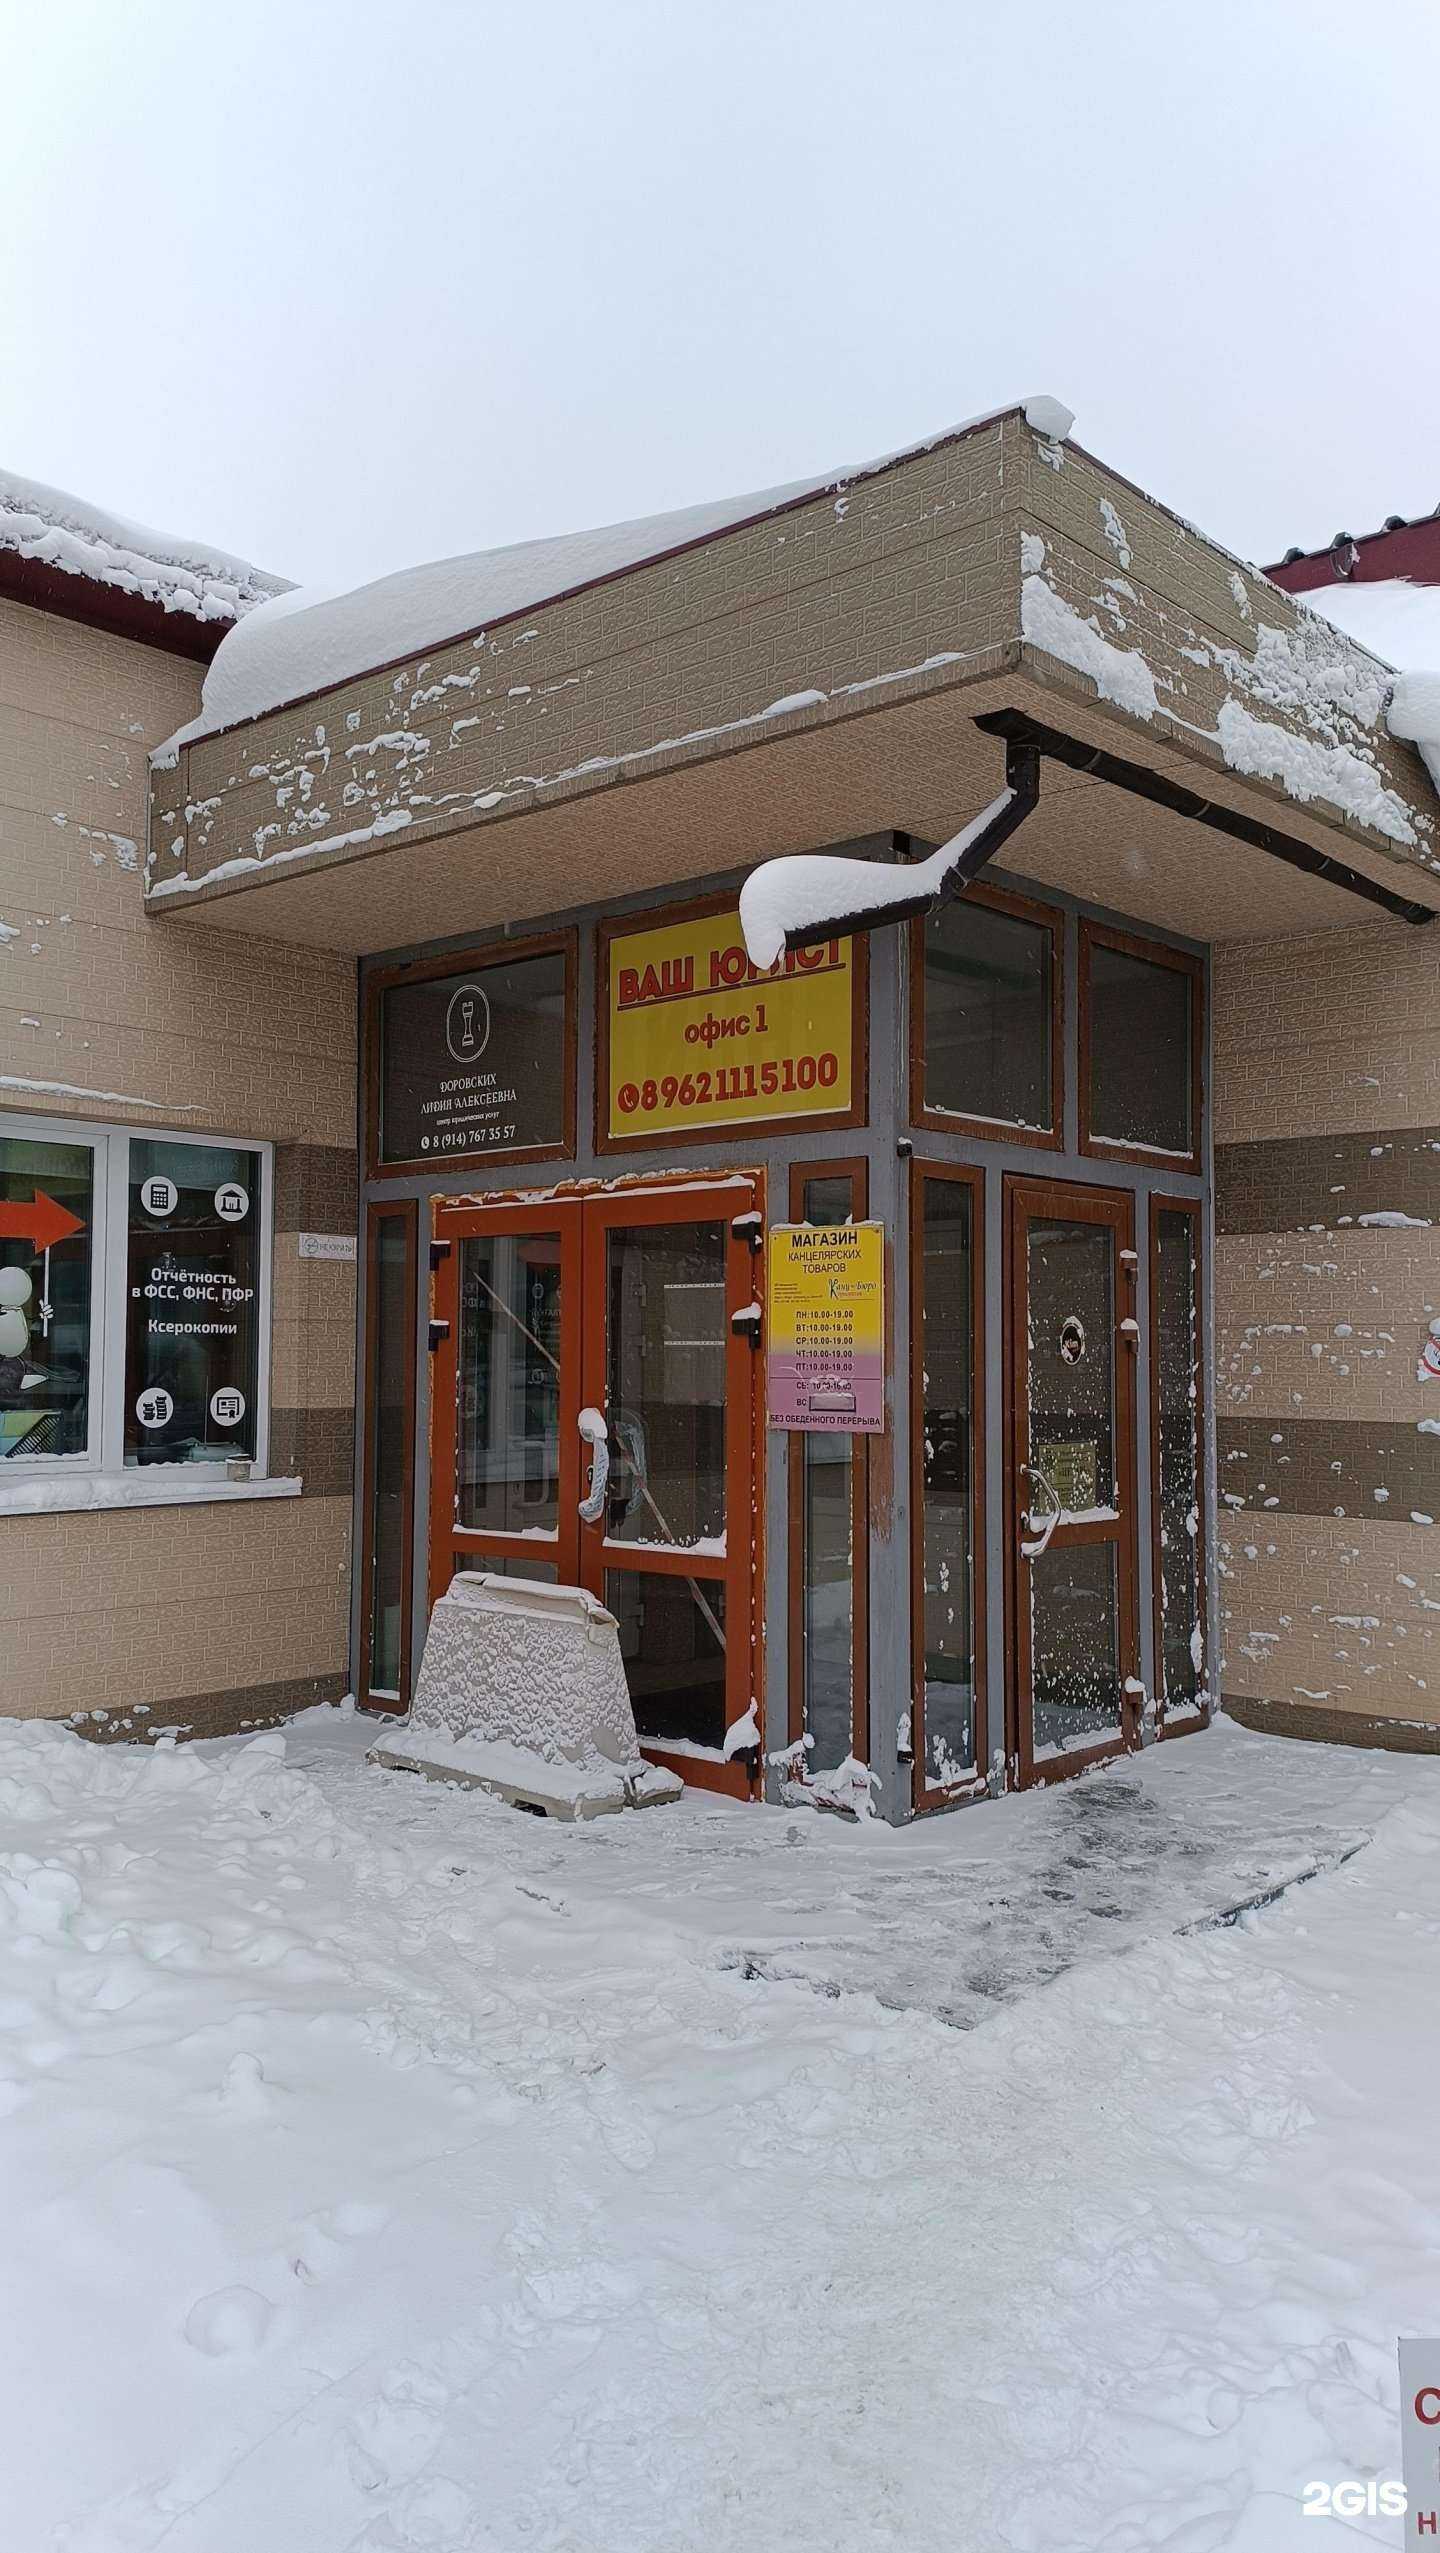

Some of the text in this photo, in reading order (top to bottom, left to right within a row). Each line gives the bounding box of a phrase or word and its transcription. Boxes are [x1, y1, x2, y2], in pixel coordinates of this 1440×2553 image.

[619, 956, 695, 1005] ВАШ
[685, 1004, 769, 1049] офис 1
[440, 1073, 497, 1093] ДОРОВСКИХ
[640, 1052, 838, 1111] 89621115100
[420, 1088, 517, 1114] ЛИДИЯ АЛЕКСЕЕВНА
[433, 1125, 516, 1149] 8 (914) 767 35 57
[792, 1231, 857, 1248] МАГАЗИН
[788, 1249, 862, 1262] КАНЦЕЛЯРСКИХ
[151, 1267, 236, 1284] Отчётность
[802, 1263, 847, 1274] ТОВАРОВ
[132, 1284, 254, 1302] в ФСС, ФНС, ПФР
[148, 1319, 238, 1335] Ксерокопии
[770, 1414, 881, 1426] БЕЗ ОБЕДЕННОГО ПЕРЕРЫВА
